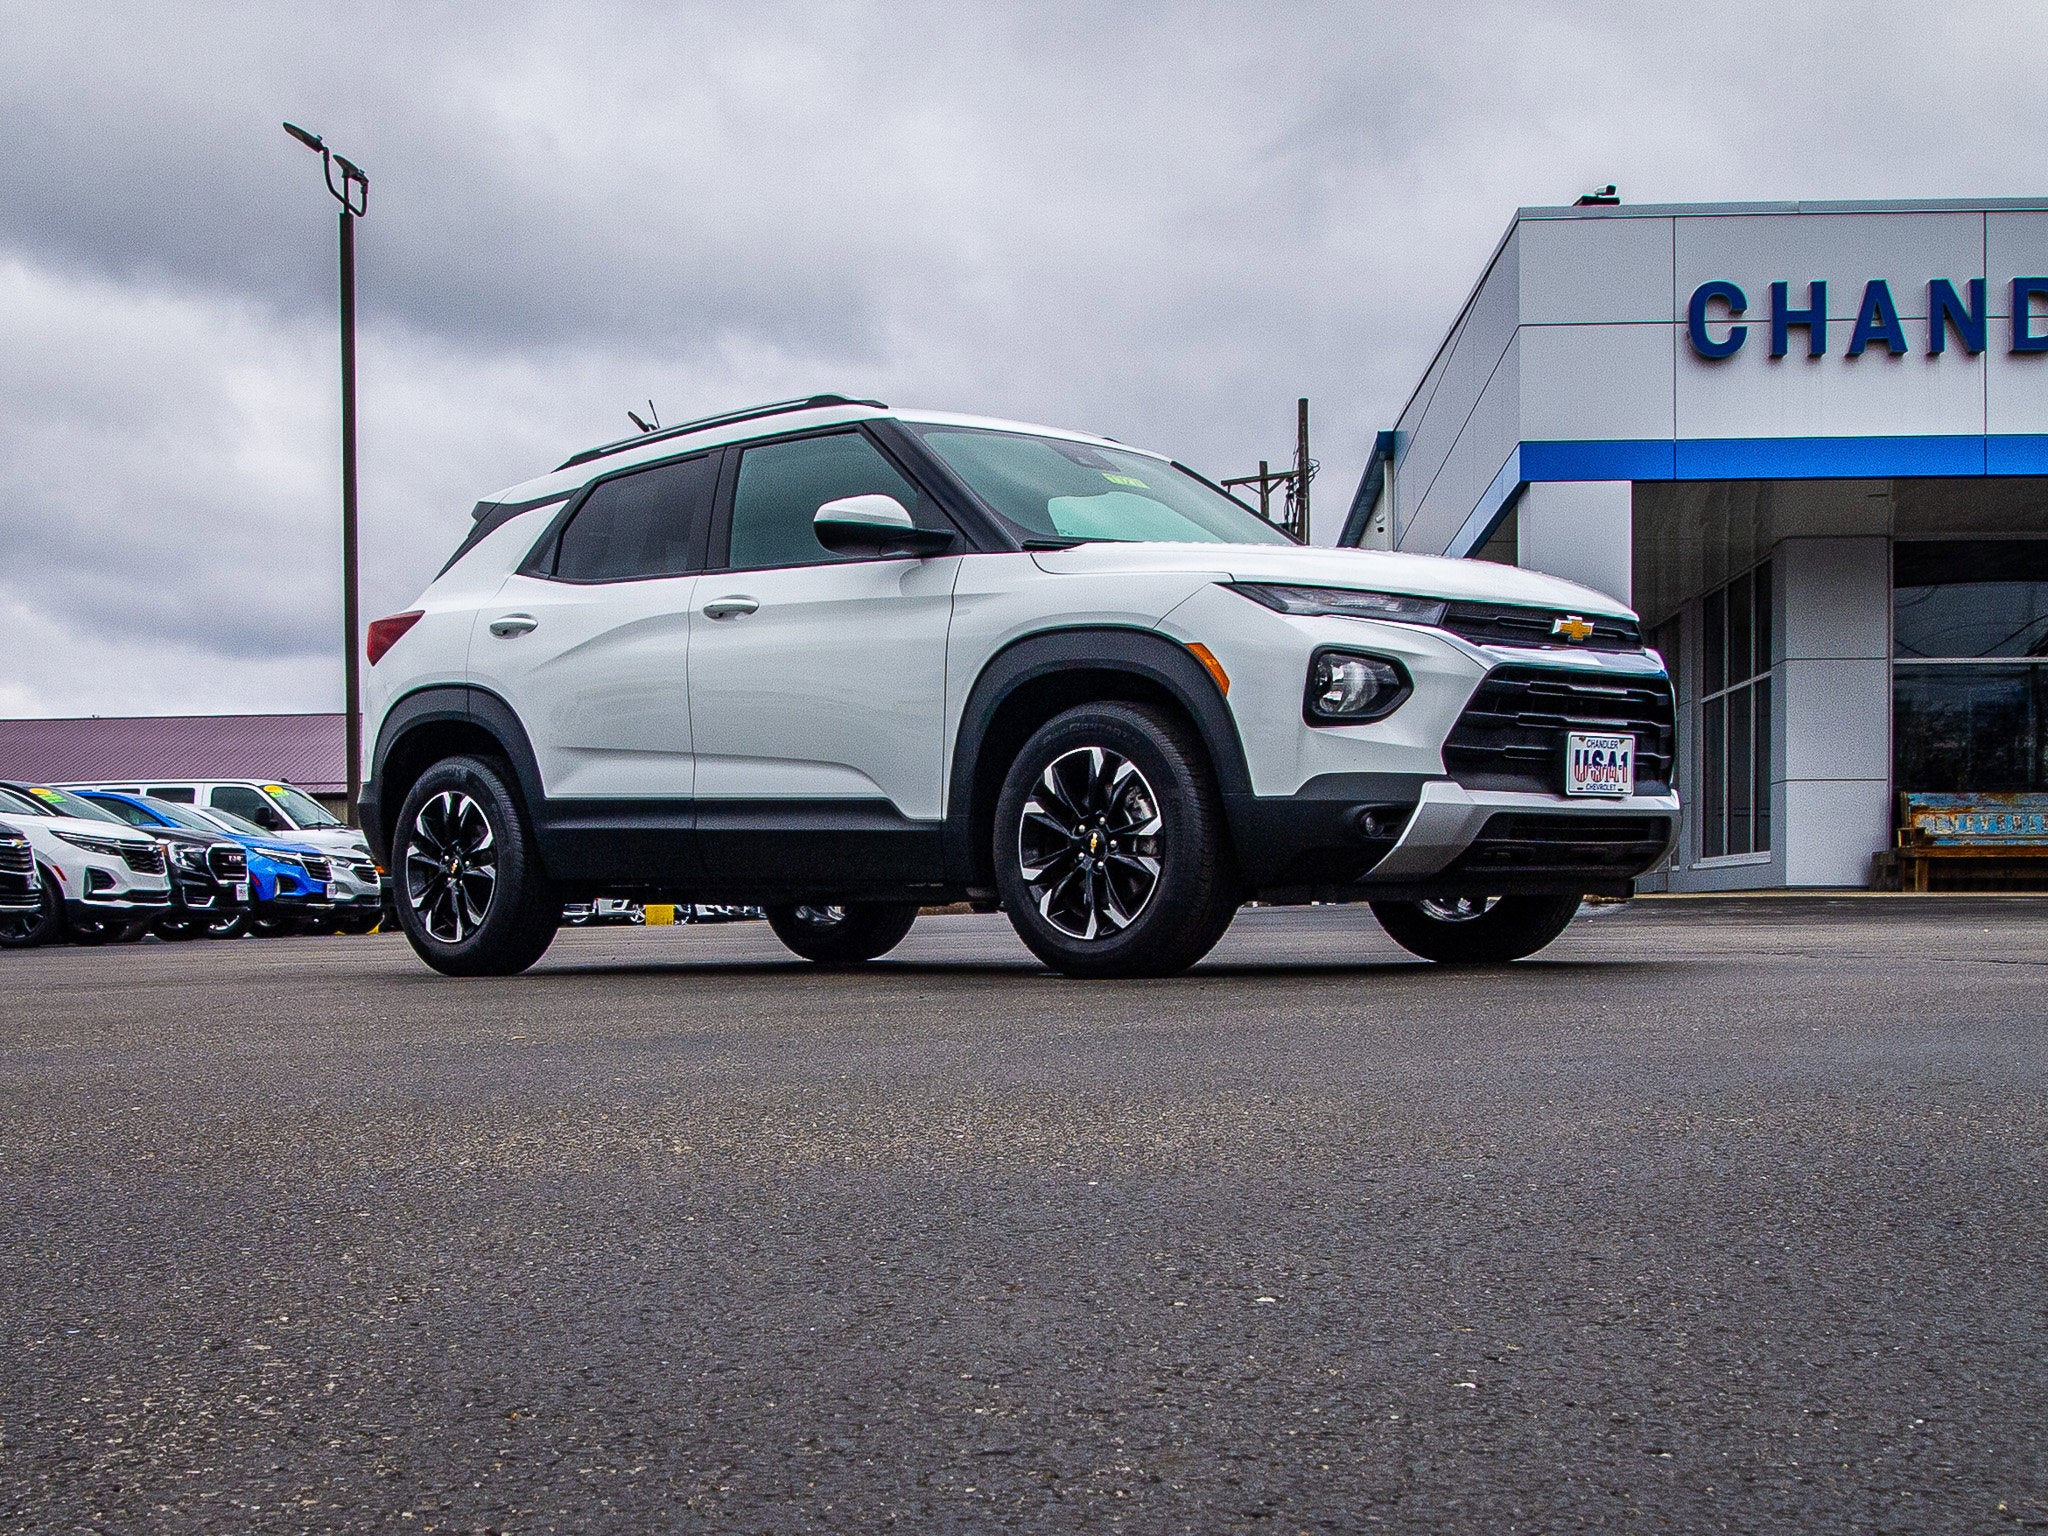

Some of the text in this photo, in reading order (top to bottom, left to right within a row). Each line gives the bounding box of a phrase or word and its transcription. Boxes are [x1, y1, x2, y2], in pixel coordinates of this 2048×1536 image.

[1687, 276, 2048, 359] CHAND
[1586, 739, 1619, 750] CHANDLER
[1585, 783, 1617, 791] CHEVROLET
